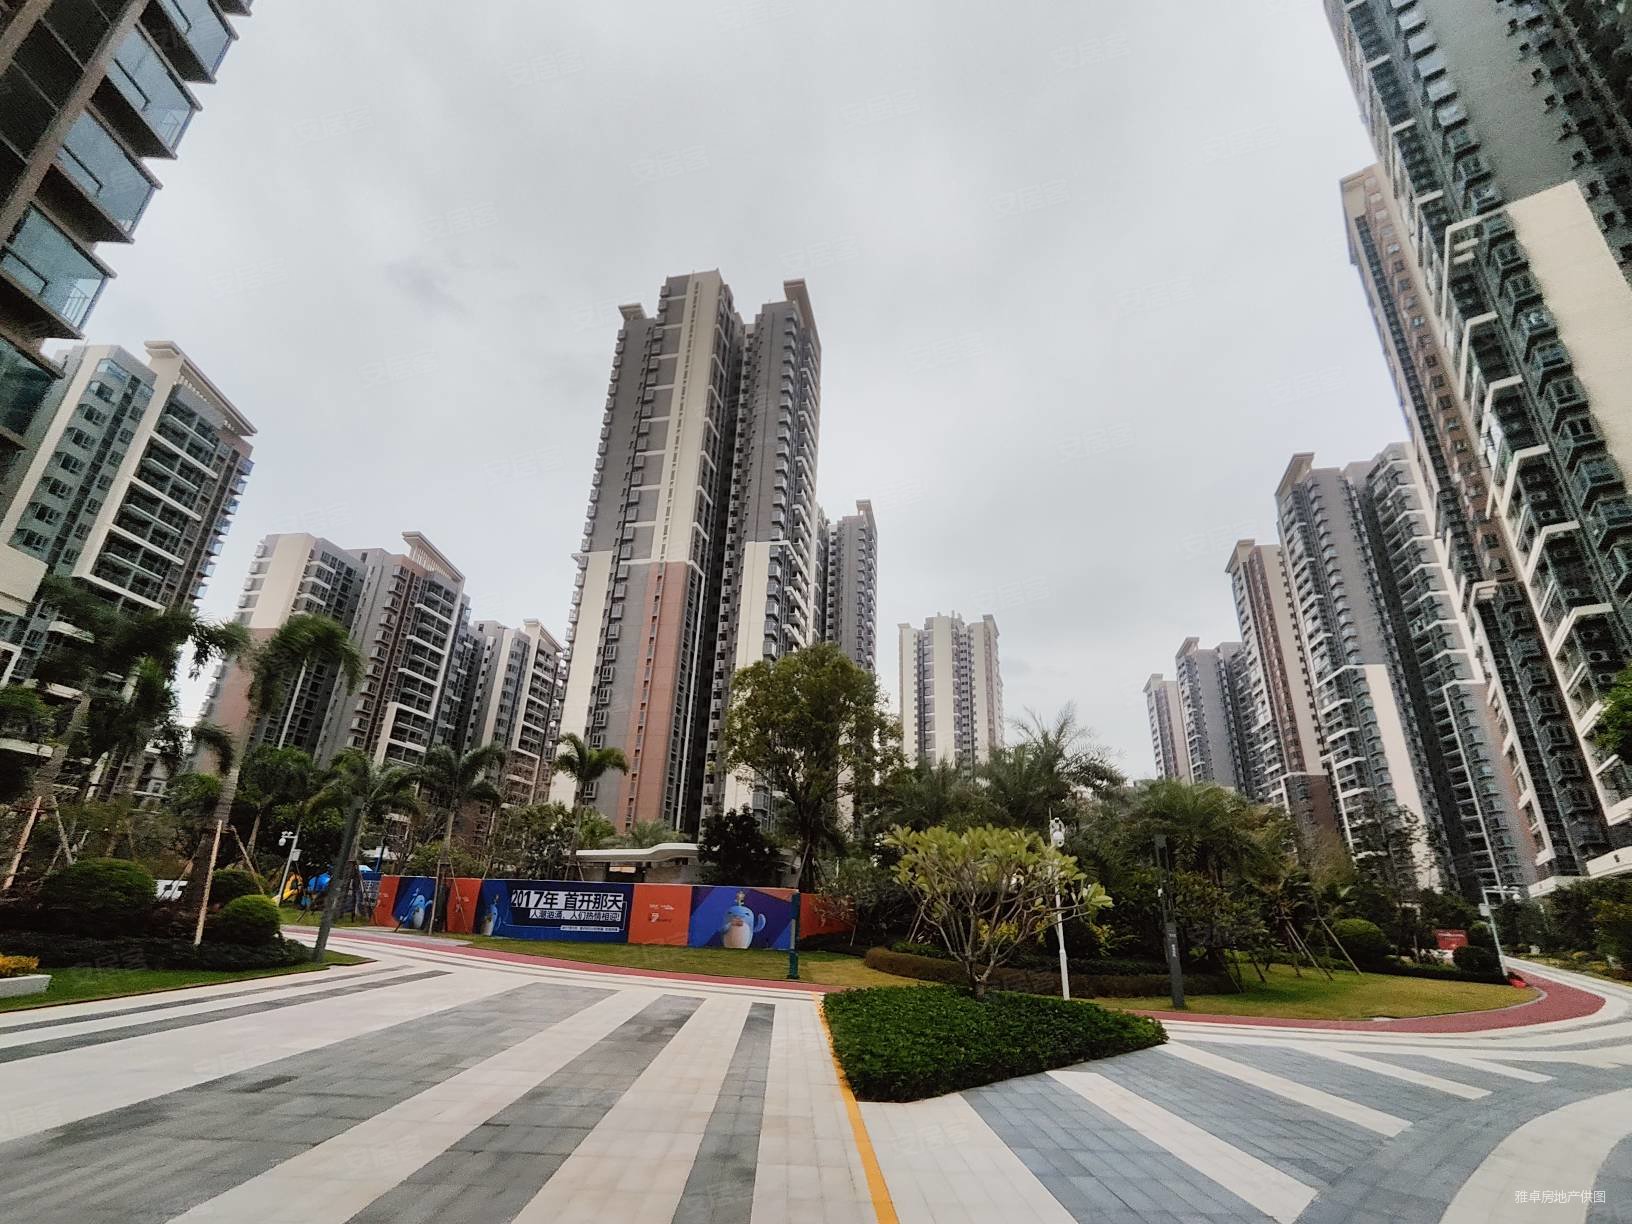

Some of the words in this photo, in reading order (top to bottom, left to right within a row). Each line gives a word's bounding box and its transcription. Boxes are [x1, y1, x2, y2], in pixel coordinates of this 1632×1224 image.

[511, 890, 559, 909] 2017年
[564, 892, 623, 911] 首开那天
